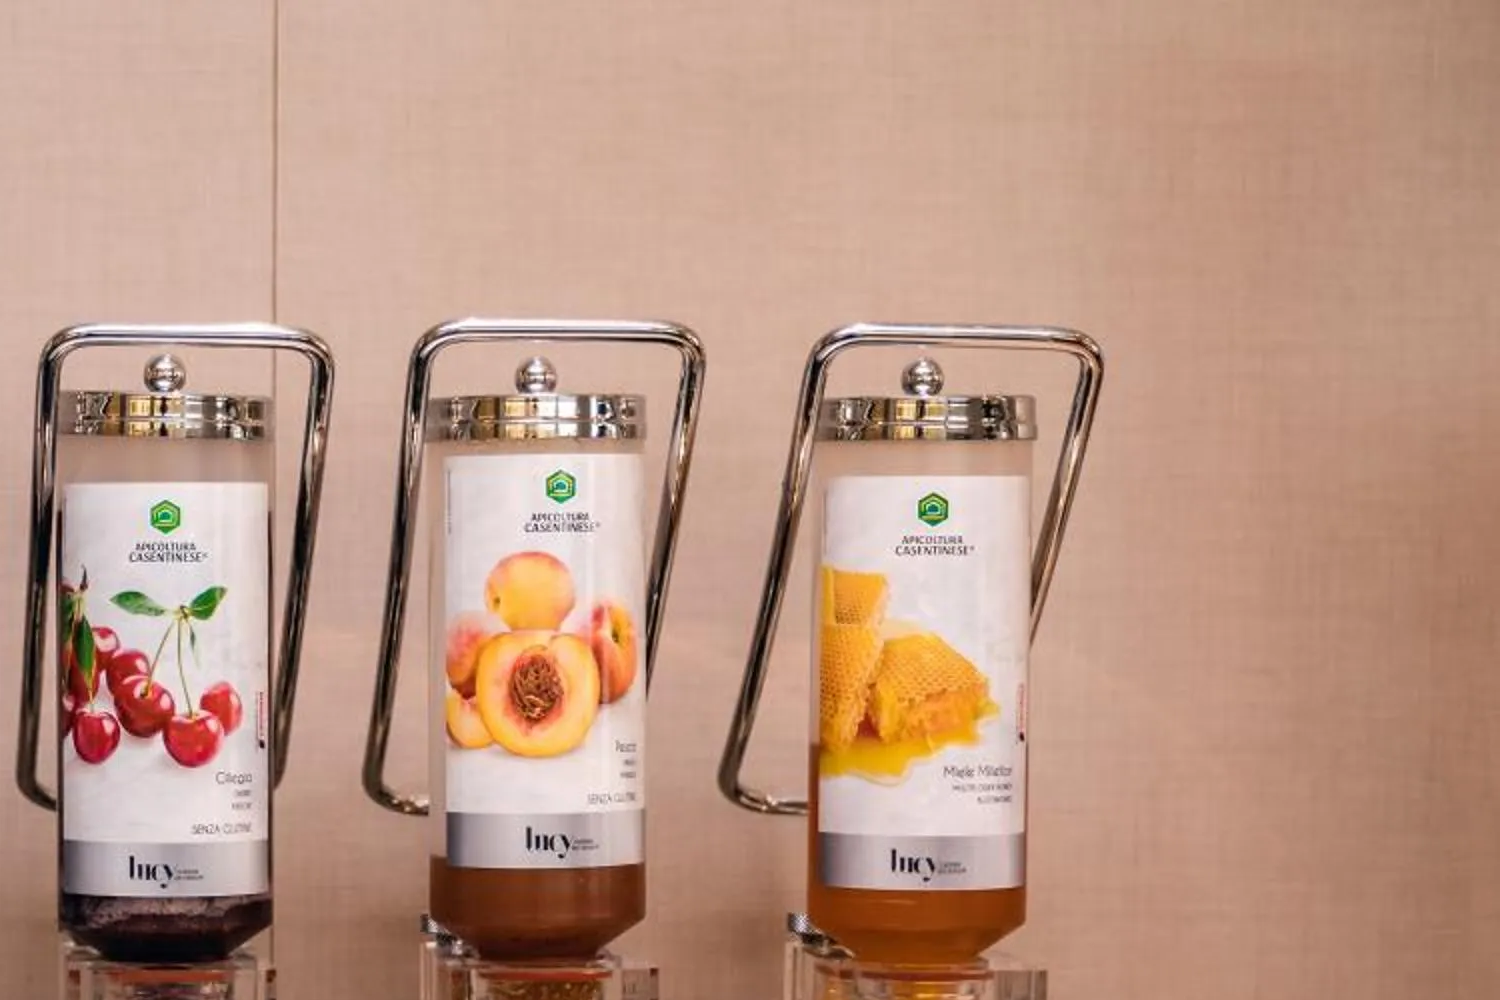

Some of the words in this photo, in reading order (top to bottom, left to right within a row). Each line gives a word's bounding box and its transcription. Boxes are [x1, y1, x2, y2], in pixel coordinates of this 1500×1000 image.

[532, 512, 590, 521] APICOLTURA
[901, 535, 963, 544] APICOLTURA
[135, 542, 197, 551] APICOLTURA
